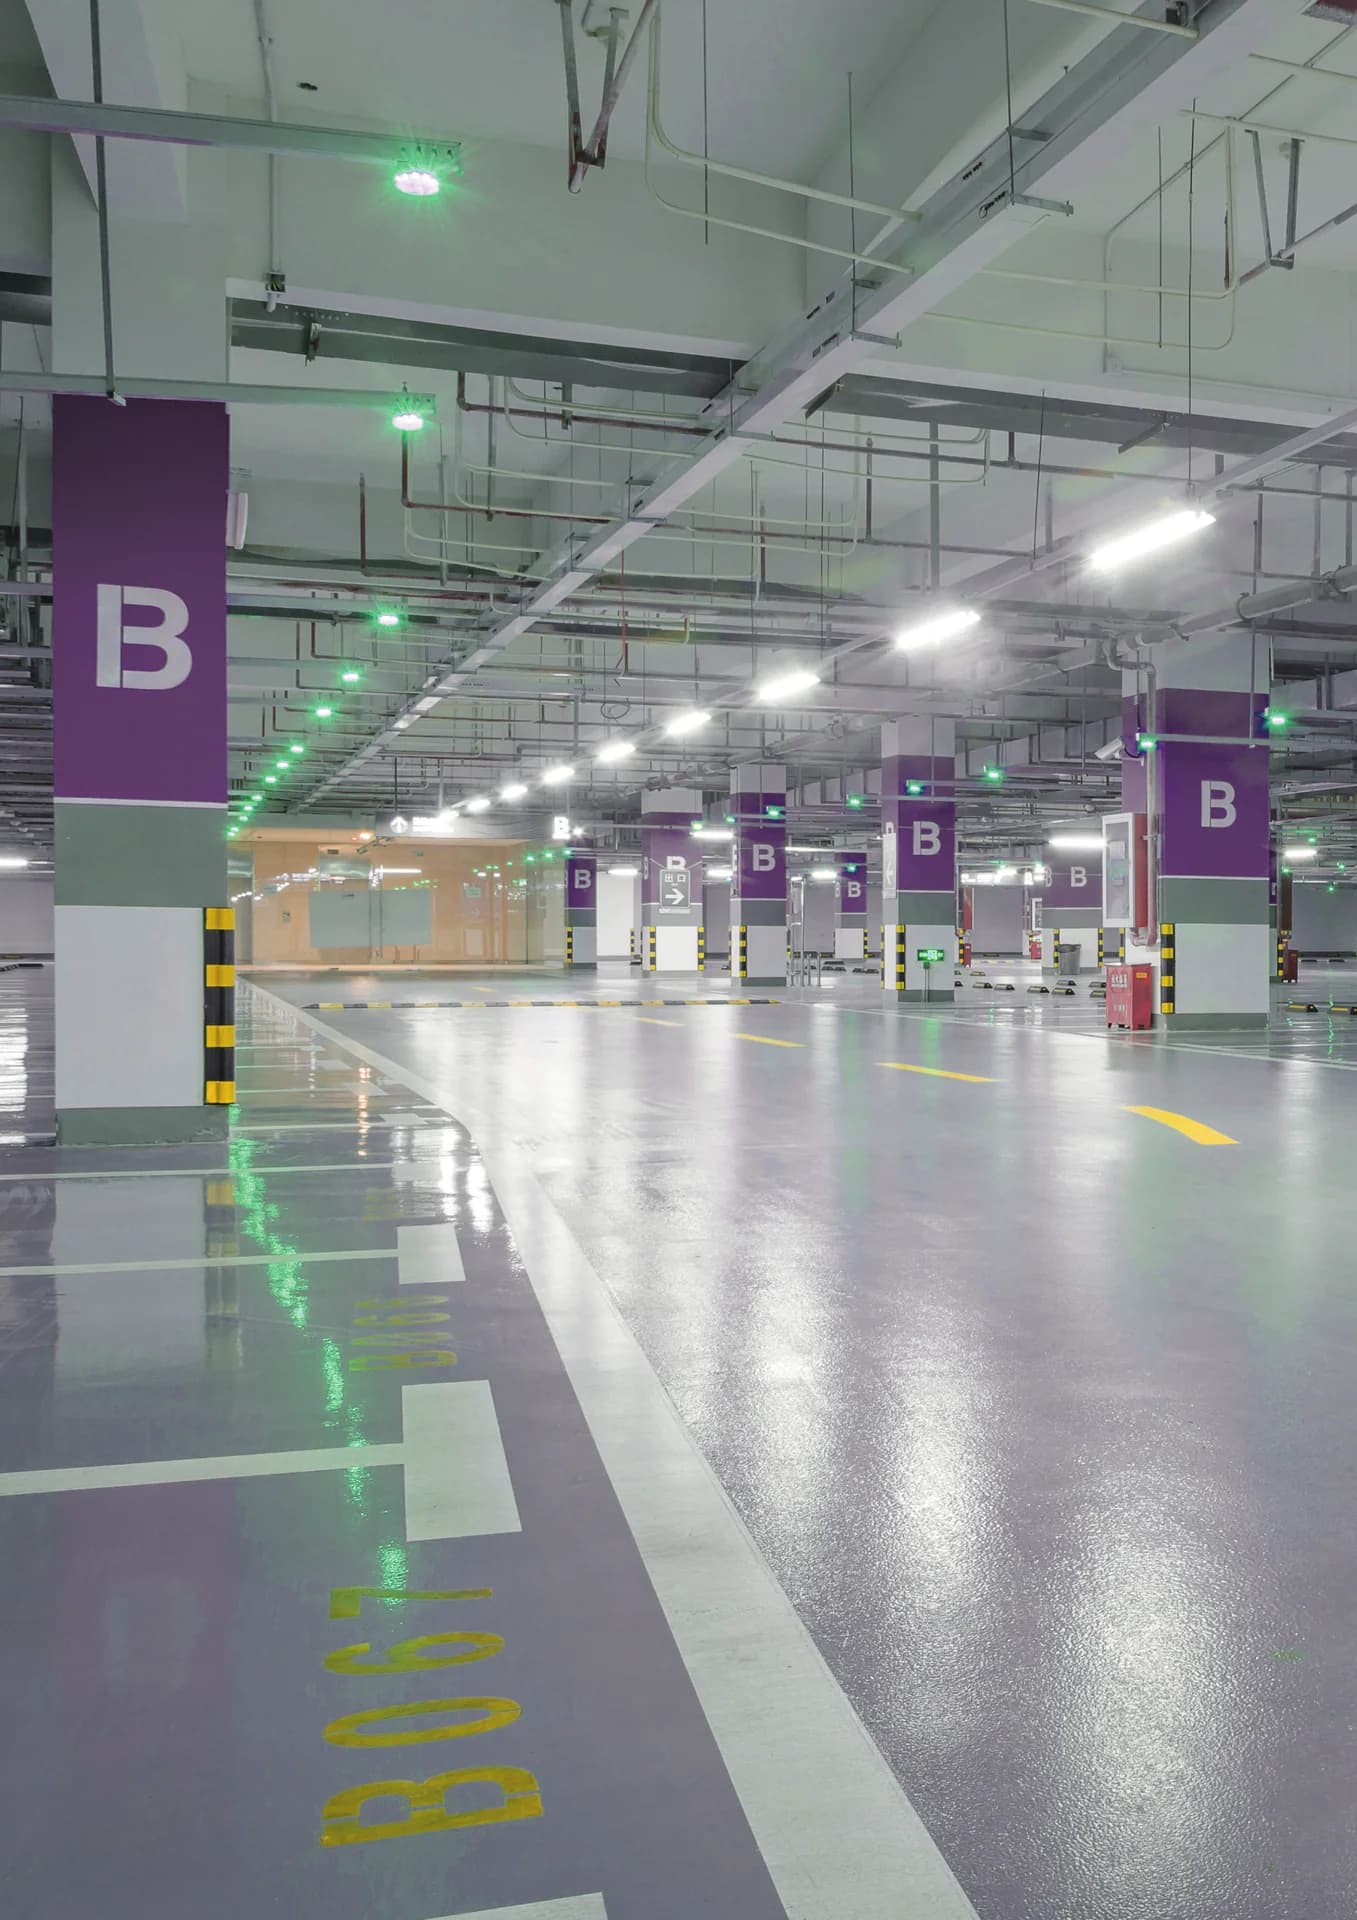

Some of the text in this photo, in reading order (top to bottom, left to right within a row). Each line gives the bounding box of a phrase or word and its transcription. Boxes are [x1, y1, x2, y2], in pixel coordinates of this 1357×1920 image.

[96, 583, 193, 690] B
[1201, 780, 1237, 828] B
[913, 820, 941, 856] B
[752, 844, 776, 872] B
[574, 869, 592, 889] B
[847, 881, 862, 898] B
[1071, 866, 1088, 888] B
[320, 1586, 544, 1847] B067
